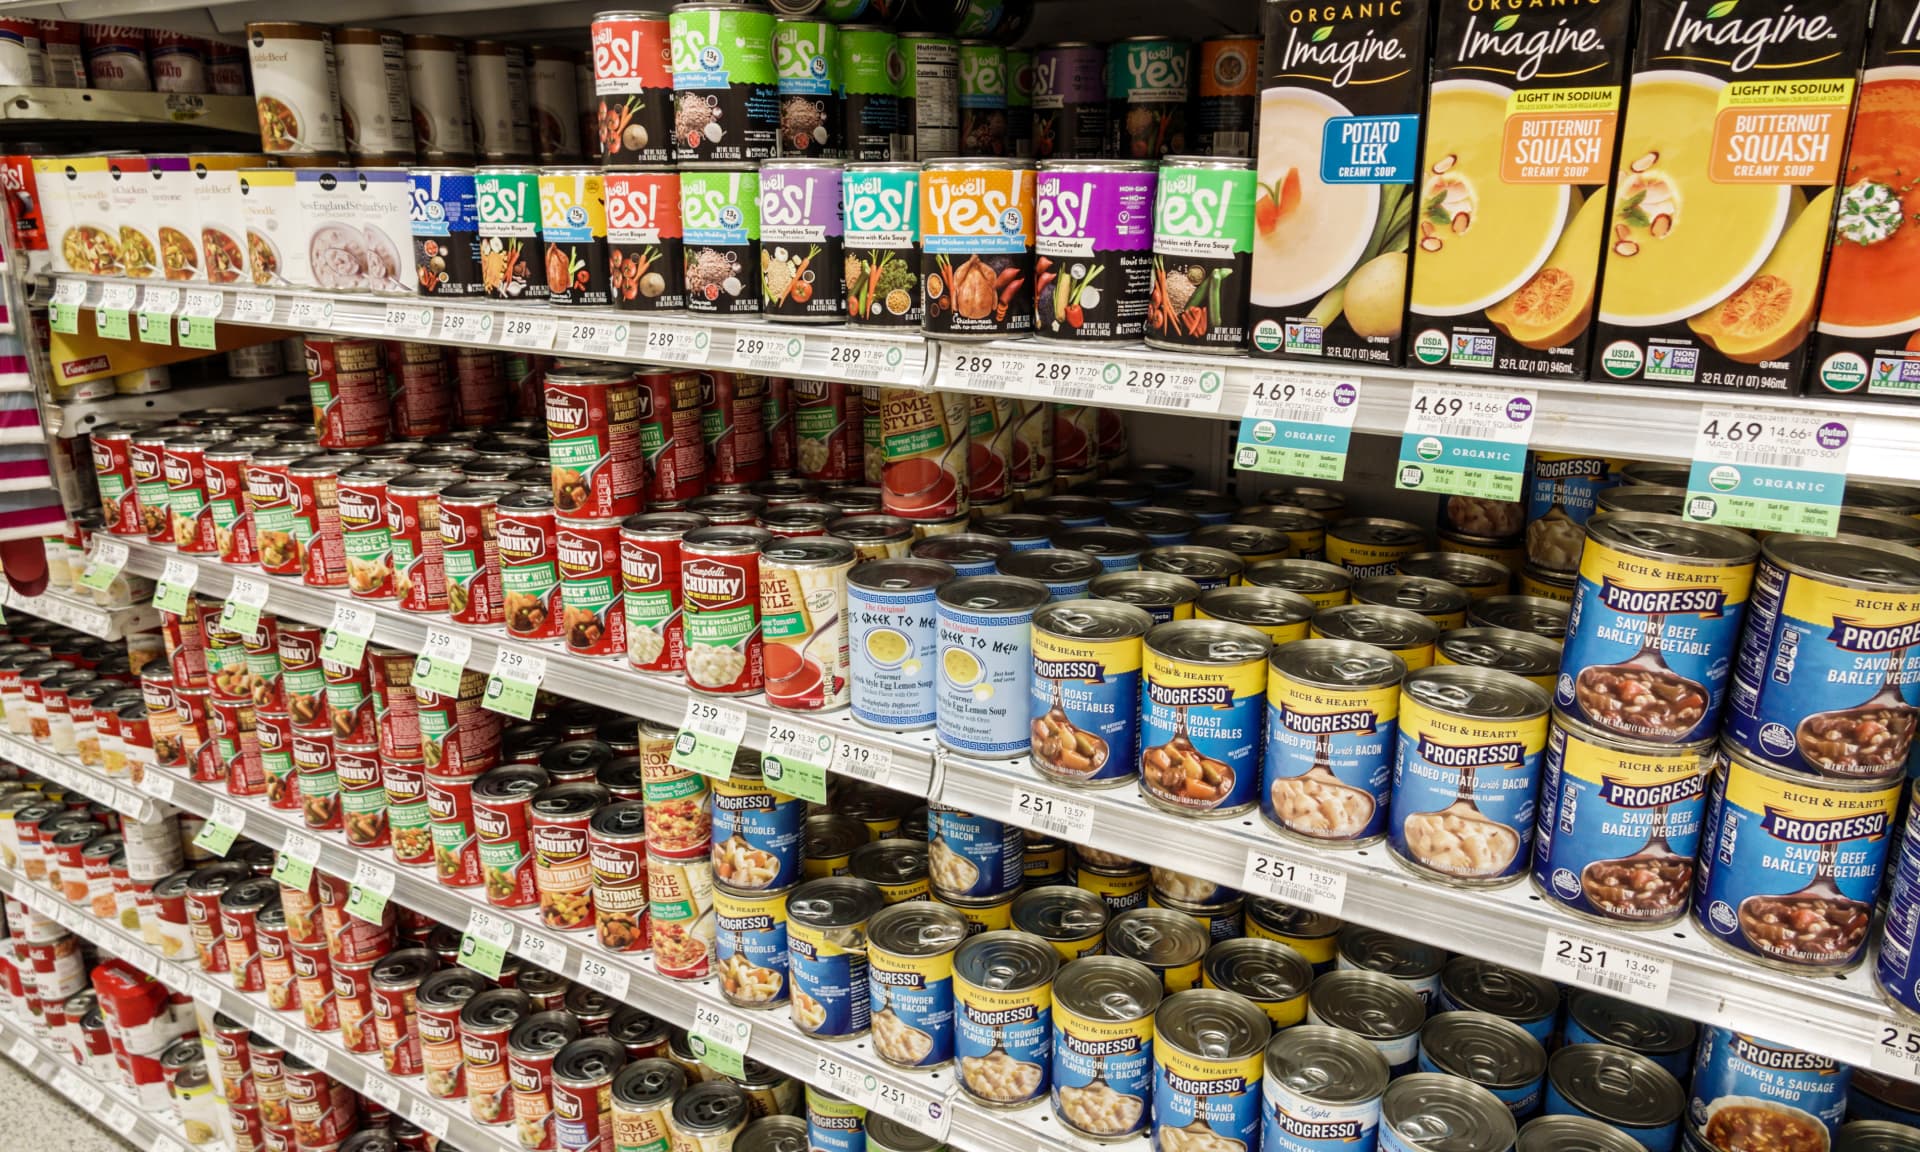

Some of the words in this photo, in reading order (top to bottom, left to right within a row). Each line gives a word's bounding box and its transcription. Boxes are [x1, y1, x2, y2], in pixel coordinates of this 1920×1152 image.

[1290, 1, 1402, 24] ORGANIC
[1664, 1, 1832, 73] Imagine
[1458, 15, 1600, 82] Imagine
[1281, 27, 1402, 88] Imagine
[1517, 93, 1550, 103] LIGHT
[1552, 92, 1565, 102] IN
[1567, 91, 1612, 101] SODIUM
[1731, 86, 1769, 96] LIGHT
[1773, 85, 1787, 95] IN
[1791, 84, 1845, 94] SODIUM
[1522, 119, 1603, 137] BUTTERNUT
[1735, 114, 1831, 133] BUTTERNUT
[1342, 121, 1400, 144] POTATO
[1351, 143, 1387, 165] LEEK
[1515, 138, 1602, 165] SQUASH
[1726, 134, 1831, 164] SQUASH
[1338, 166, 1372, 178] CREAMY
[1374, 166, 1397, 178] SOUP
[1521, 166, 1560, 177] CREAMY
[1564, 166, 1589, 177] SOUP
[1733, 165, 1780, 177] CREAMY
[1783, 165, 1814, 176] SOUP
[854, 178, 882, 195] well
[951, 178, 986, 196] well
[1260, 327, 1277, 336] USDA
[736, 339, 764, 354] 2.89
[1423, 337, 1443, 346] USDA
[830, 347, 861, 363] 2.89
[1612, 349, 1635, 359] USDA
[1673, 356, 1695, 365] GMO
[1674, 350, 1696, 359] NON
[954, 355, 992, 373] 2.89
[1035, 363, 1071, 381] 2.89
[1605, 360, 1640, 370] ORGANIC
[1646, 366, 1694, 376] VERIFIED
[1832, 360, 1858, 371] USDA
[1126, 371, 1166, 389] 2.89
[1702, 373, 1711, 384] 32
[1713, 374, 1721, 385] FL
[1761, 377, 1788, 390] 946mL
[1825, 373, 1862, 383] ORGANIC
[1252, 382, 1296, 402] 4.69
[882, 396, 931, 416] HOME
[1414, 396, 1463, 417] 4.69
[883, 410, 936, 432] STYLE
[1284, 431, 1336, 443] ORGANIC
[1703, 419, 1763, 442] 4.69
[1819, 428, 1848, 438] gluten
[574, 444, 594, 455] WITH
[1822, 437, 1841, 447] free
[1452, 447, 1511, 461] ORGANIC
[1536, 460, 1601, 478] PROGRESSO
[1554, 485, 1592, 497] ENGLAND
[1752, 477, 1825, 492] ORGANIC
[503, 573, 529, 582] BEEF
[531, 569, 551, 579] WITH
[1617, 561, 1647, 576] RICH
[1651, 568, 1662, 579] &
[1665, 572, 1720, 584] HEARTY
[684, 572, 741, 595] CHUNKY
[1608, 586, 1718, 612] PROGRESSO
[864, 603, 876, 612] The
[877, 604, 905, 614] Original
[708, 613, 750, 625] ENGLAND
[861, 612, 890, 627] GREEK
[897, 614, 915, 628] TO
[692, 626, 717, 637] CLAM
[718, 622, 752, 635] CHOWDER
[1615, 616, 1665, 637] SAVORY
[1667, 626, 1699, 641] BEEF
[1841, 621, 1920, 650] PROGRE
[971, 634, 987, 649] TO
[1596, 626, 1643, 646] BARLEY
[1644, 635, 1712, 657] VEGETABLE
[1032, 662, 1096, 679] PROGRESSO
[1853, 657, 1906, 671] SAVORY
[874, 672, 901, 682] Gourmet
[879, 678, 892, 690] Egg
[893, 680, 915, 690] Lemon
[917, 679, 933, 690] Soup
[1183, 671, 1225, 682] HEARTY
[1827, 669, 1884, 686] BARLEY
[947, 691, 973, 704] Gourmet
[1064, 689, 1093, 701] ROAST
[1150, 684, 1226, 704] PROGRESSO
[951, 702, 964, 714] Egg
[965, 705, 988, 716] Lemon
[989, 705, 1007, 717] Soup
[1061, 700, 1115, 714] VEGETABLES
[1152, 705, 1169, 718] BEEF
[1171, 710, 1187, 722] POT
[1190, 714, 1222, 727] ROAST
[1286, 712, 1371, 733] PROGRESSO
[1150, 717, 1184, 734] COUNTRY
[1186, 723, 1242, 739] VEGETABLES
[1472, 728, 1519, 739] HEARTY
[1274, 729, 1299, 748] LOADED
[1300, 739, 1334, 754] POTATO
[1355, 744, 1382, 755] BACON
[1424, 744, 1519, 767] PROGRESSO
[1409, 761, 1440, 781] LOADED
[1441, 773, 1480, 789] POTATO
[1502, 777, 1529, 789] BACON
[1611, 776, 1704, 807] PROGRESSO
[1784, 790, 1818, 806] RICH
[1822, 797, 1834, 808] &
[1838, 798, 1886, 809] HEARTY
[1019, 793, 1052, 815] 2.51
[1622, 812, 1668, 826] SAVORY
[1671, 810, 1693, 823] BEEF
[1602, 822, 1648, 838] BARLEY
[1652, 823, 1699, 838] VEGETABLE
[1774, 814, 1885, 842] PROGRESSO
[1785, 846, 1838, 862] SAVORY
[1840, 851, 1868, 865] BEEF
[1255, 857, 1296, 881] 2.51
[1762, 855, 1815, 876] BARLEY
[1818, 863, 1876, 878] VEGETABLE
[1556, 939, 1608, 969] 2.51
[968, 1006, 1033, 1025] PROGRESSO
[1009, 1027, 1045, 1039] CHOWDER
[1014, 1036, 1040, 1048] BACON
[1067, 1037, 1136, 1055] PROGRESSO
[1110, 1056, 1148, 1070] CHOWDER
[1736, 1040, 1835, 1069] PROGRESSO
[1727, 1057, 1774, 1084] CHICKEN
[1776, 1075, 1786, 1087] &
[1788, 1078, 1836, 1094] SAUSAGE
[1168, 1078, 1241, 1095] PROGRESSO
[1759, 1083, 1801, 1101] GUMBO
[1194, 1101, 1233, 1113] ENGLAND
[1300, 1104, 1332, 1119] Light
[1193, 1110, 1236, 1122] CHOWDER
[1279, 1114, 1356, 1139] PROGRESSO
